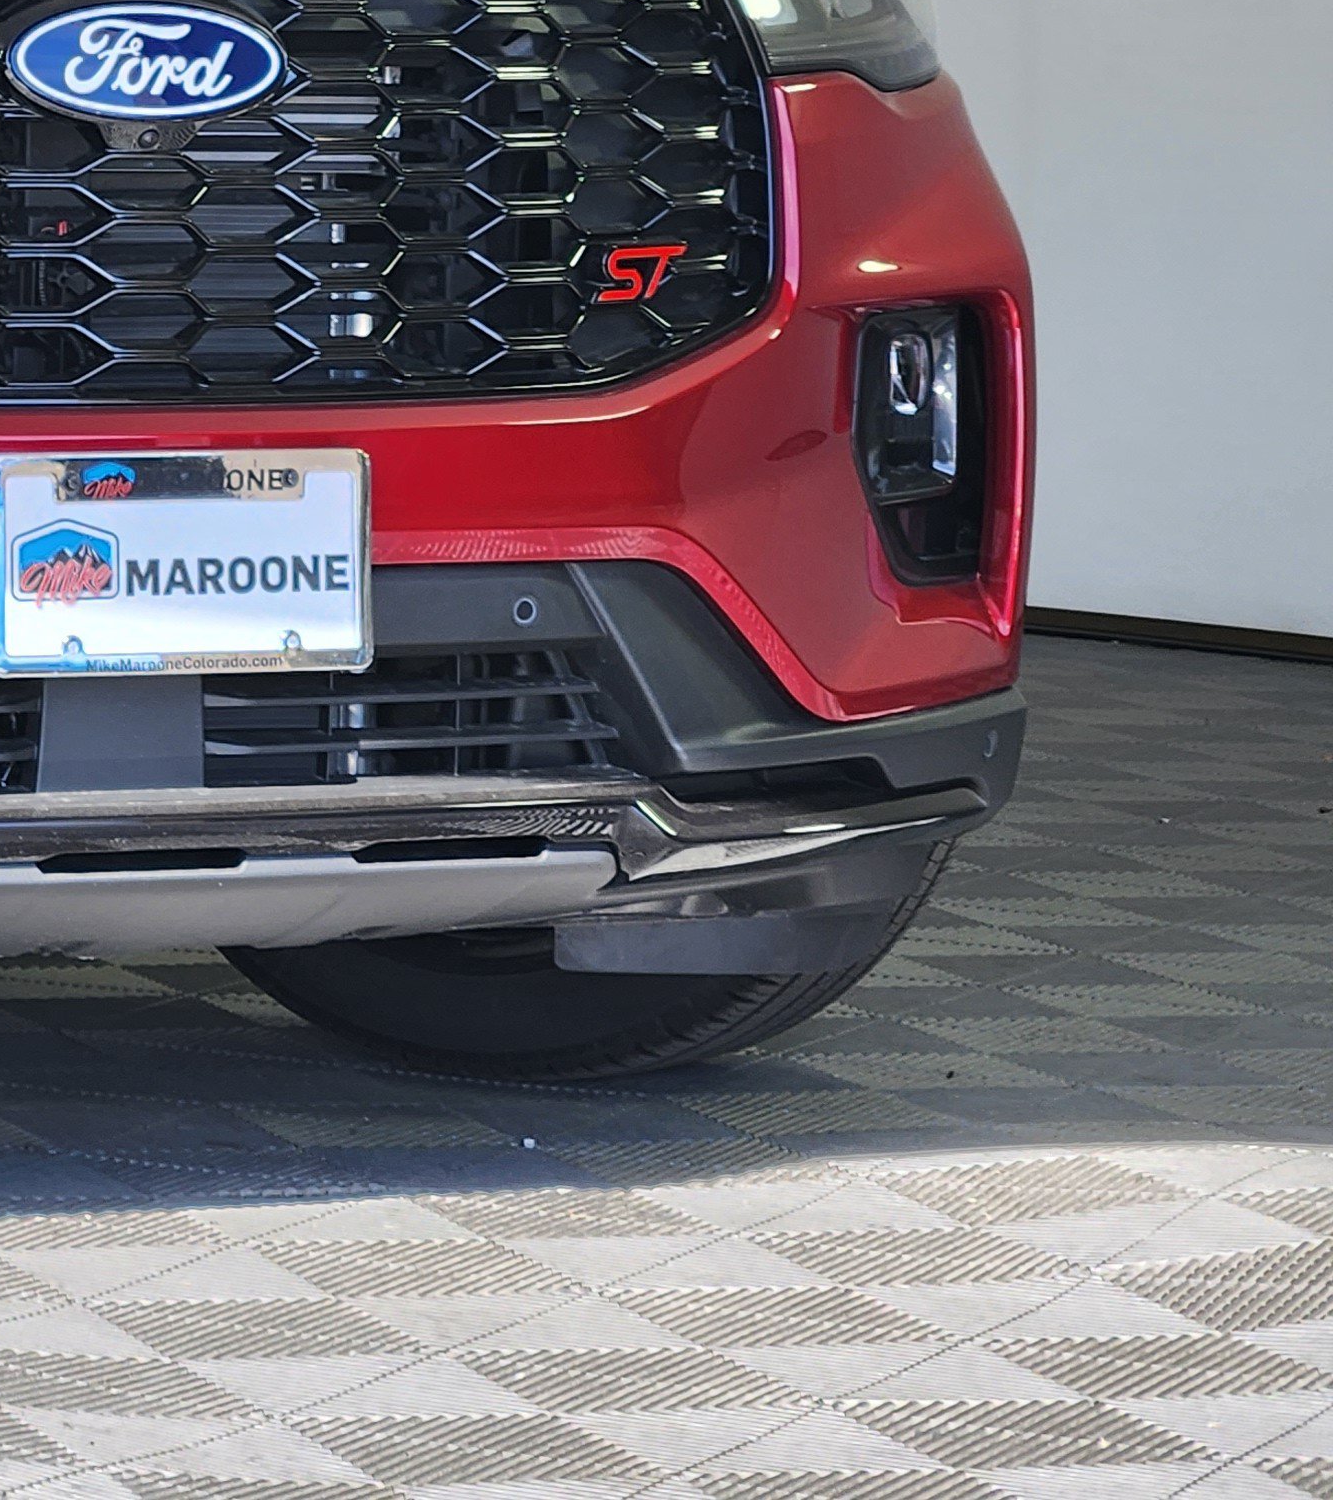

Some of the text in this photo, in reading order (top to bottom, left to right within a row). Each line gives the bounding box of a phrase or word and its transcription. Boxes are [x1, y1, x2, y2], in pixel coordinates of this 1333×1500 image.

[64, 18, 235, 97] Ford
[597, 245, 689, 302] ST
[83, 477, 133, 499] Mike
[19, 554, 351, 608] Mike MAROONE
